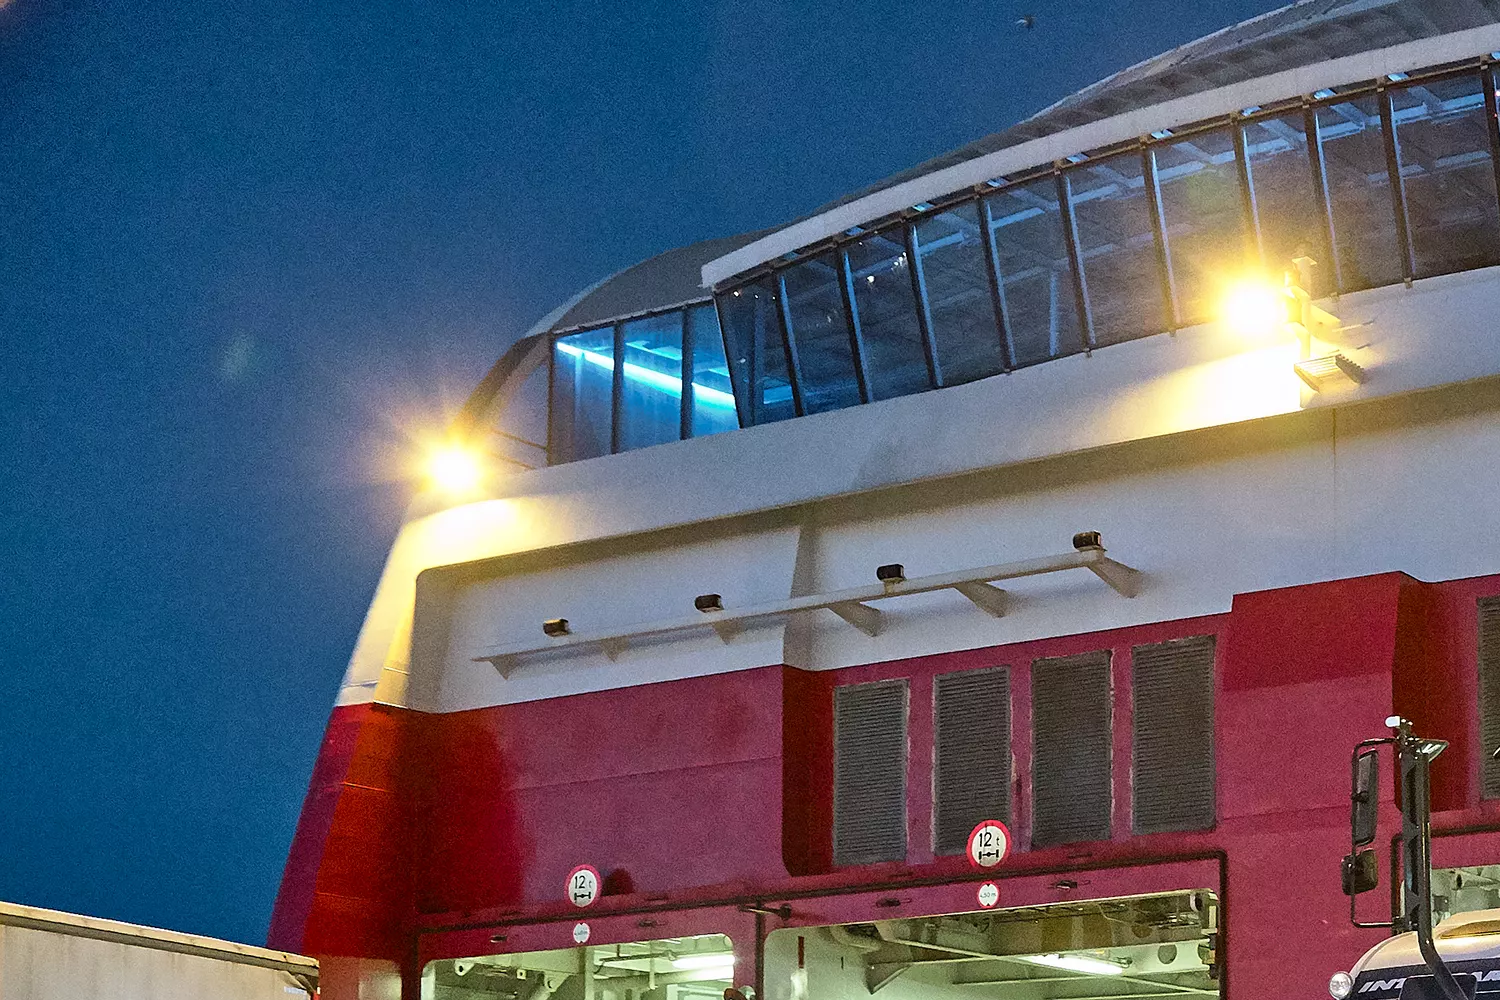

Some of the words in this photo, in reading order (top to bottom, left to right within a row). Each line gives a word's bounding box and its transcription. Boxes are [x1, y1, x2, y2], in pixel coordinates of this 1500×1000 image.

[979, 832, 992, 847] 12
[996, 837, 1000, 846] t
[574, 875, 586, 889] 12
